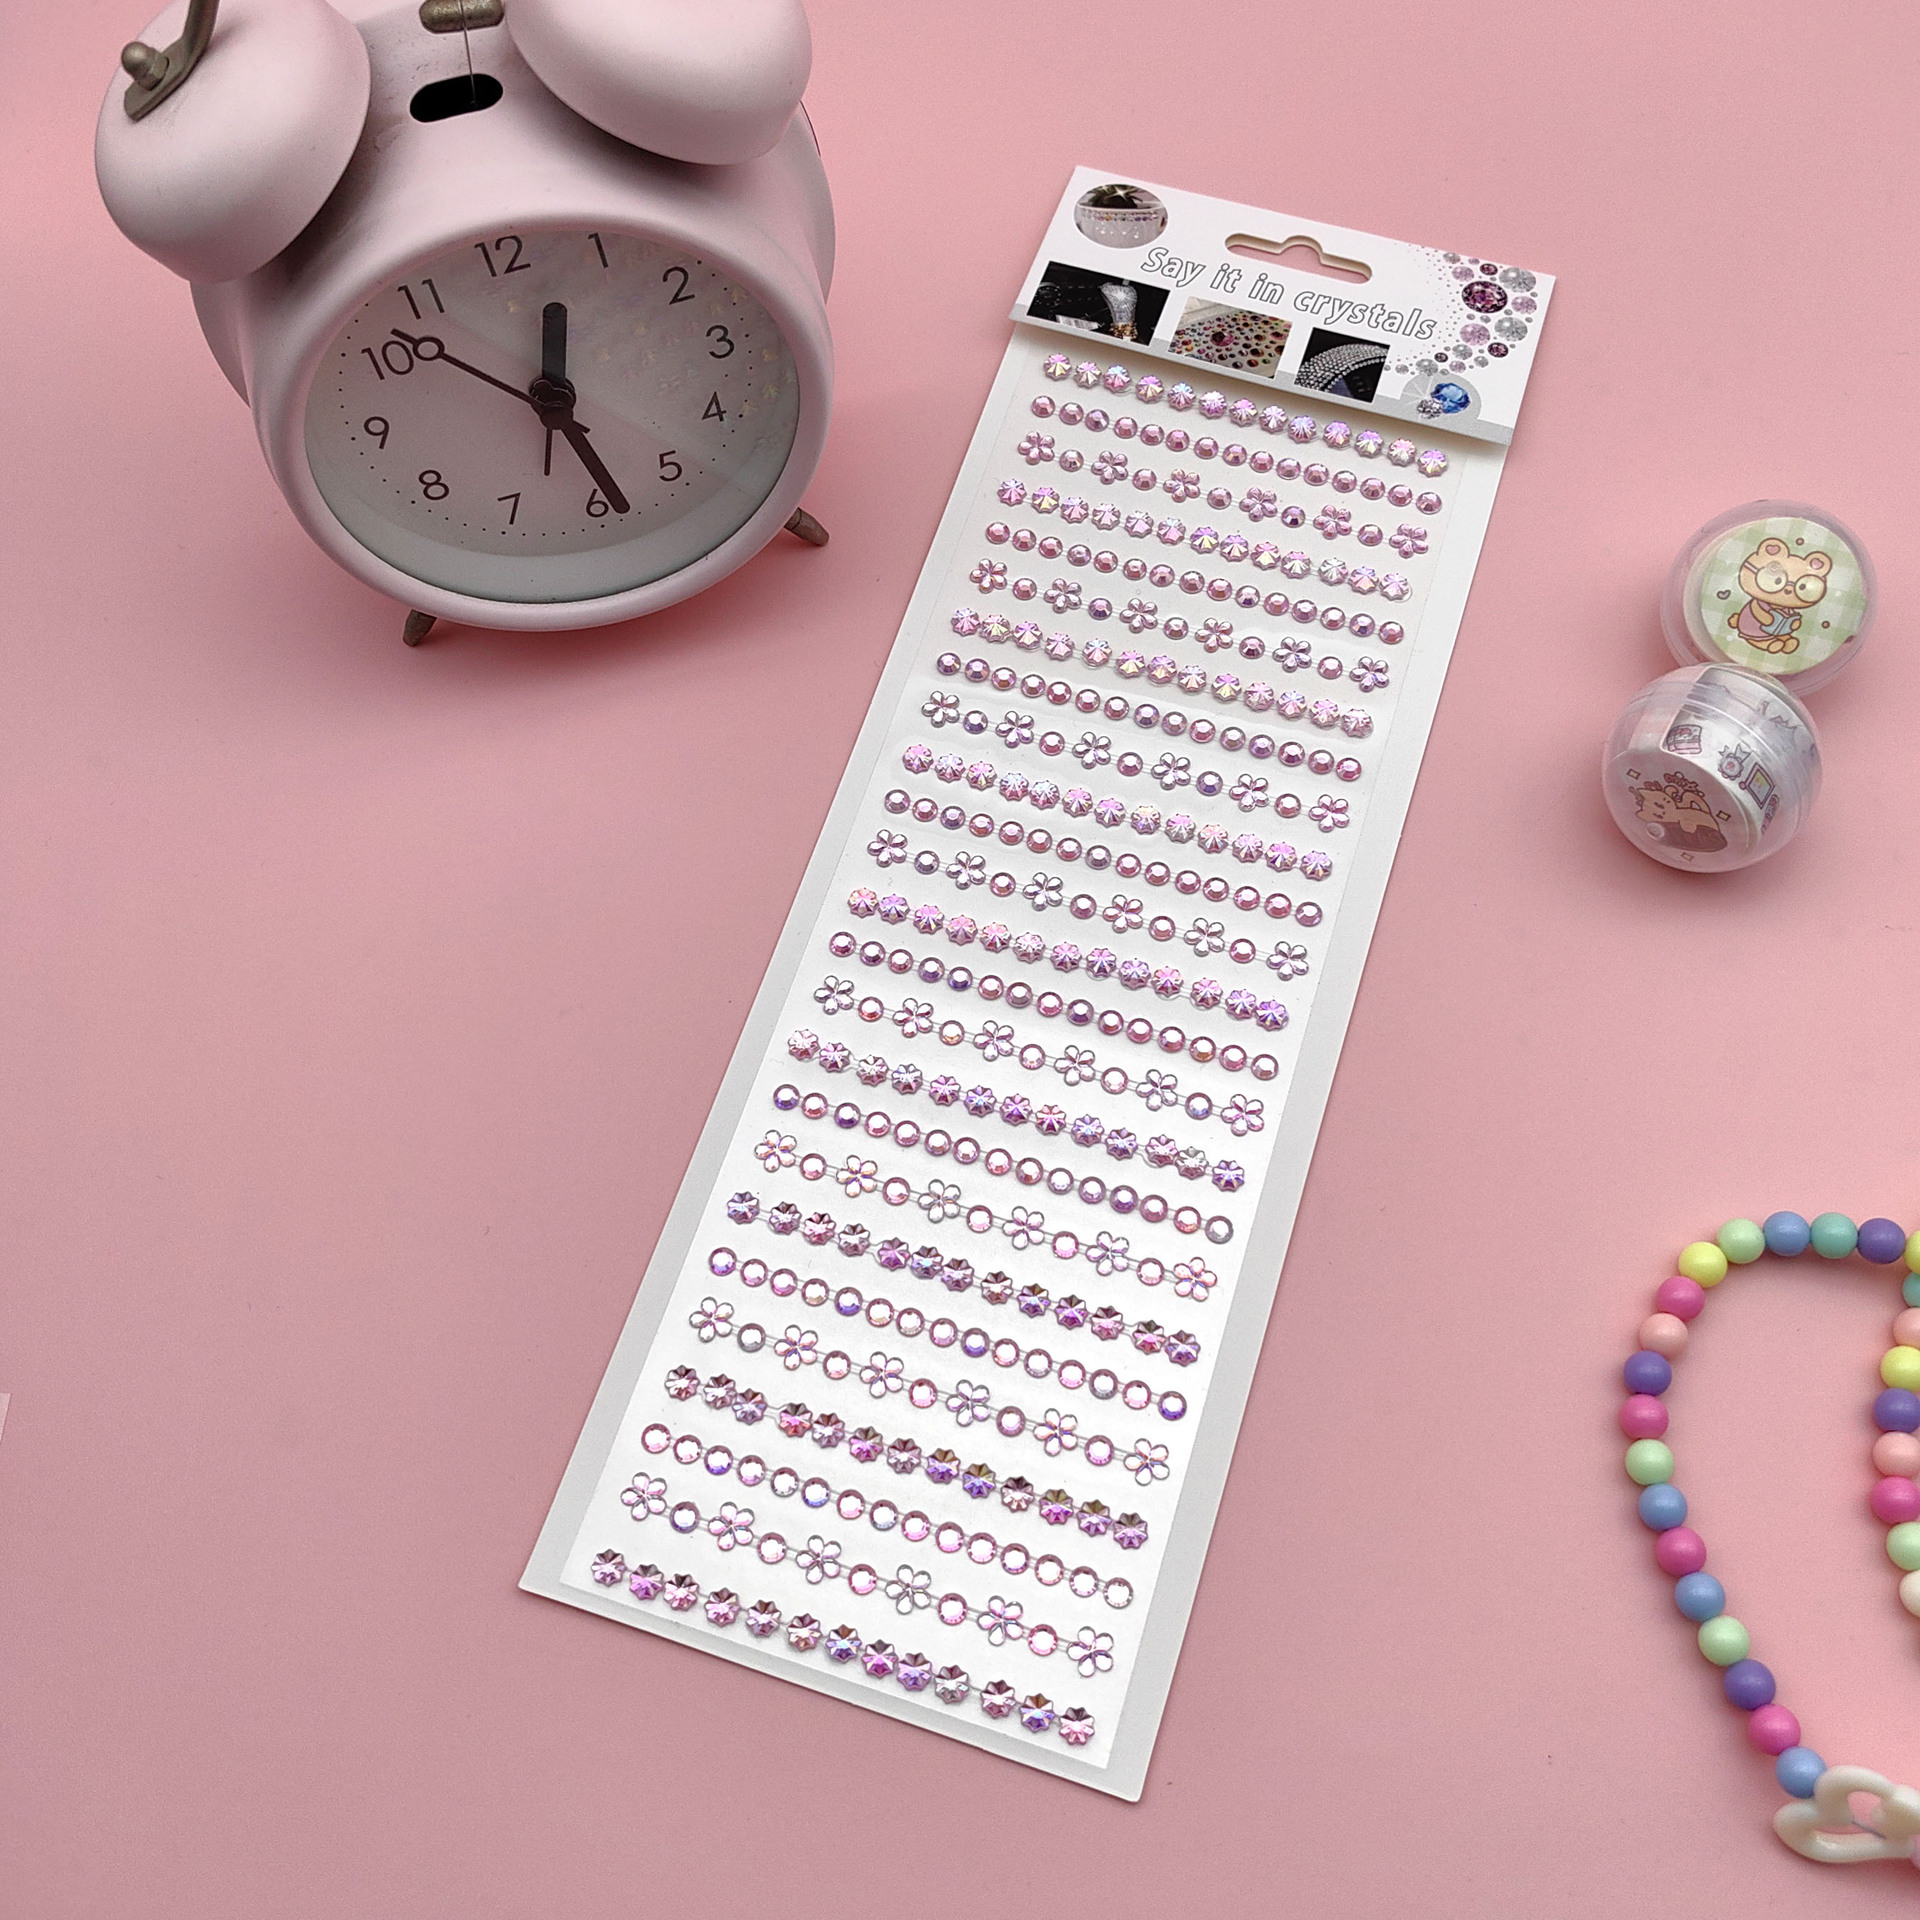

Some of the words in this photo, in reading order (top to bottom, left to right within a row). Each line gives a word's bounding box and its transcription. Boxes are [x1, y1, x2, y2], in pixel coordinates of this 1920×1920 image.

[475, 235, 531, 278] 12
[588, 233, 609, 268] 1
[398, 279, 446, 319] 11
[662, 266, 695, 304] 2
[1140, 247, 1206, 287] Say
[1210, 263, 1242, 293] it
[1248, 273, 1285, 304] in
[1293, 291, 1437, 340] crystals
[705, 324, 735, 358] 3
[362, 340, 415, 380] 10
[701, 391, 727, 423] 4
[363, 416, 390, 450] 9
[658, 450, 683, 482] 5
[418, 470, 450, 500] 8
[497, 493, 521, 525] 7
[585, 488, 609, 518] 6
